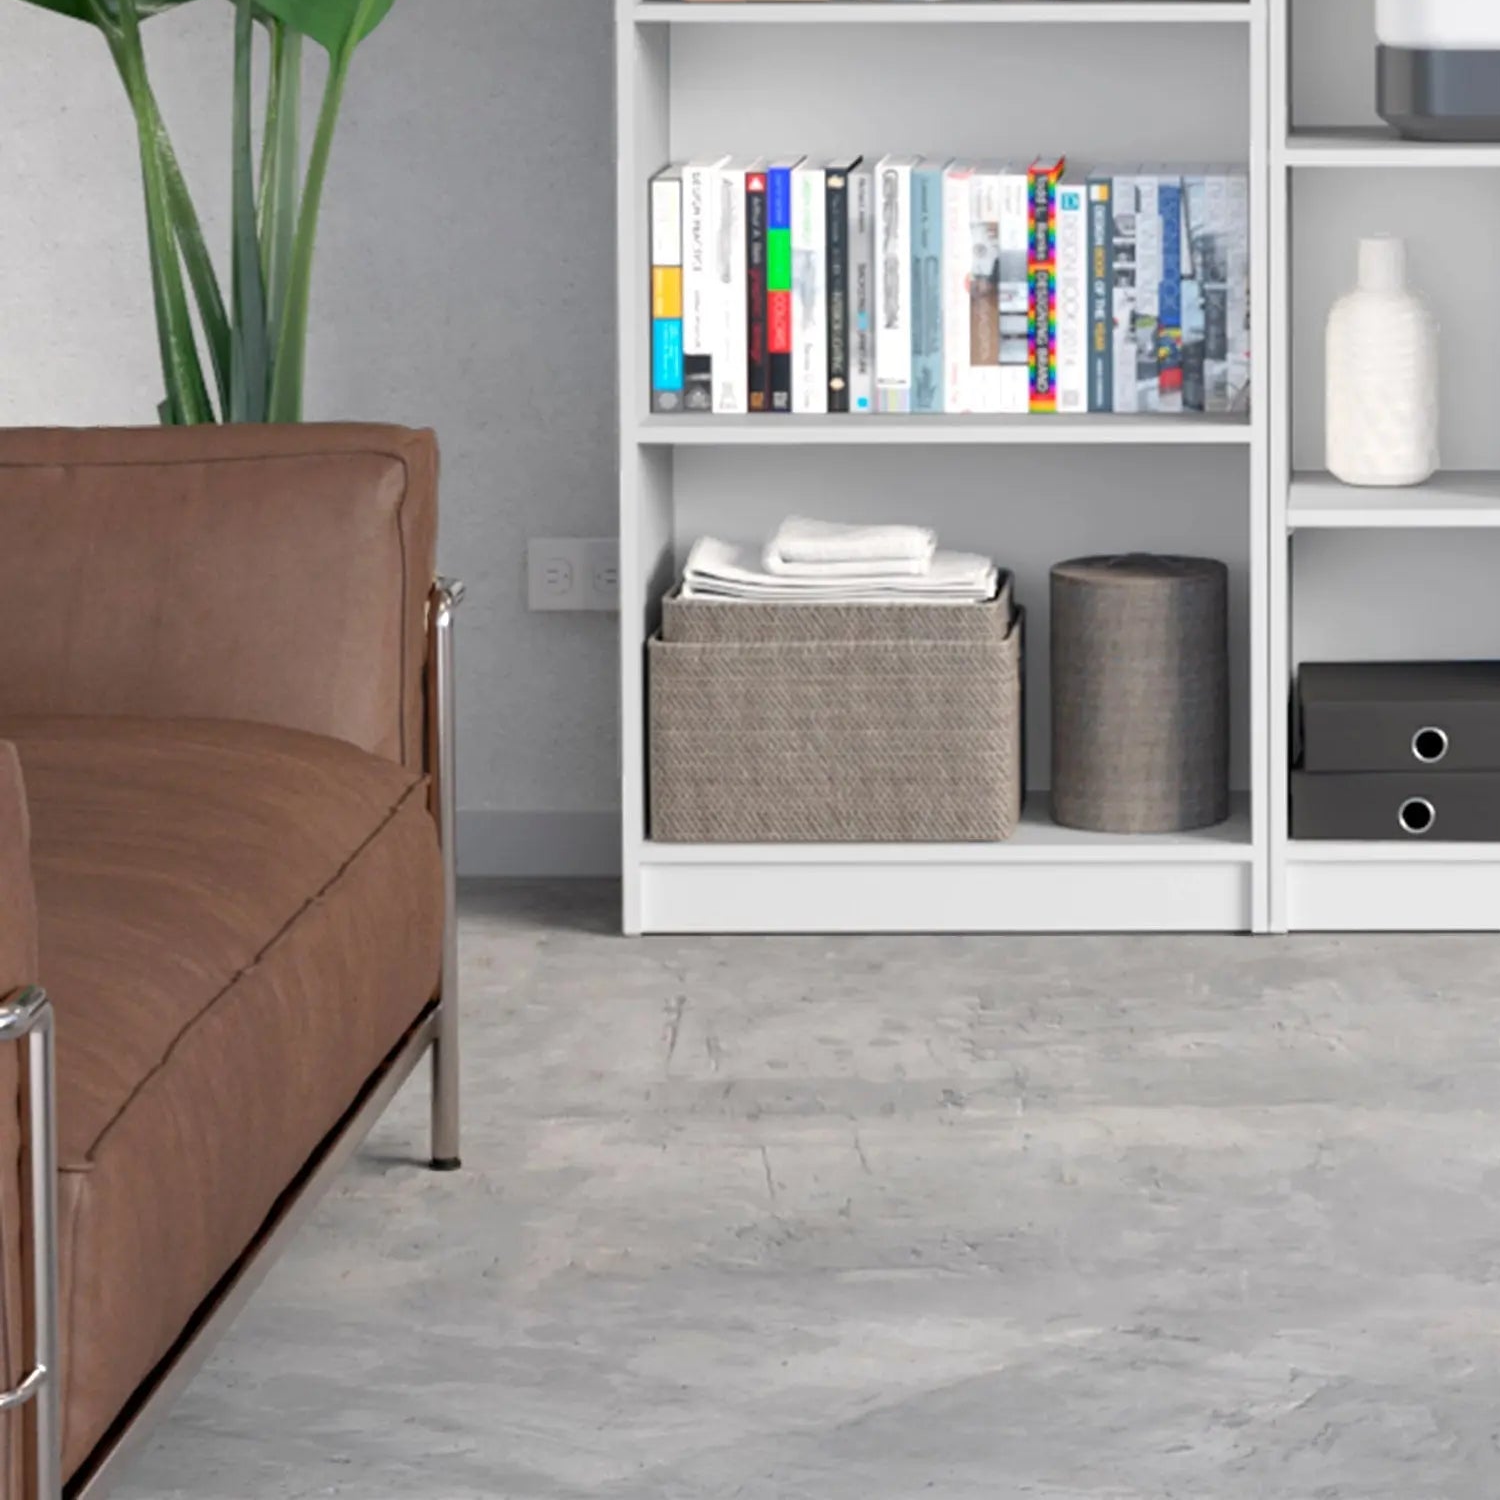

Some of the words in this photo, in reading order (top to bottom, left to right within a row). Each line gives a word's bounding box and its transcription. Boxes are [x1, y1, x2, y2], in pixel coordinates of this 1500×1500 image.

[1065, 214, 1079, 272] DESIGN
[1094, 204, 1105, 245] DESIGN
[1094, 247, 1105, 277] BOOK
[1036, 271, 1049, 345] DESIGNING
[1065, 276, 1079, 323] BOOK
[1094, 280, 1105, 296] OF
[1094, 298, 1105, 319] THE
[1036, 347, 1049, 393] BRAND
